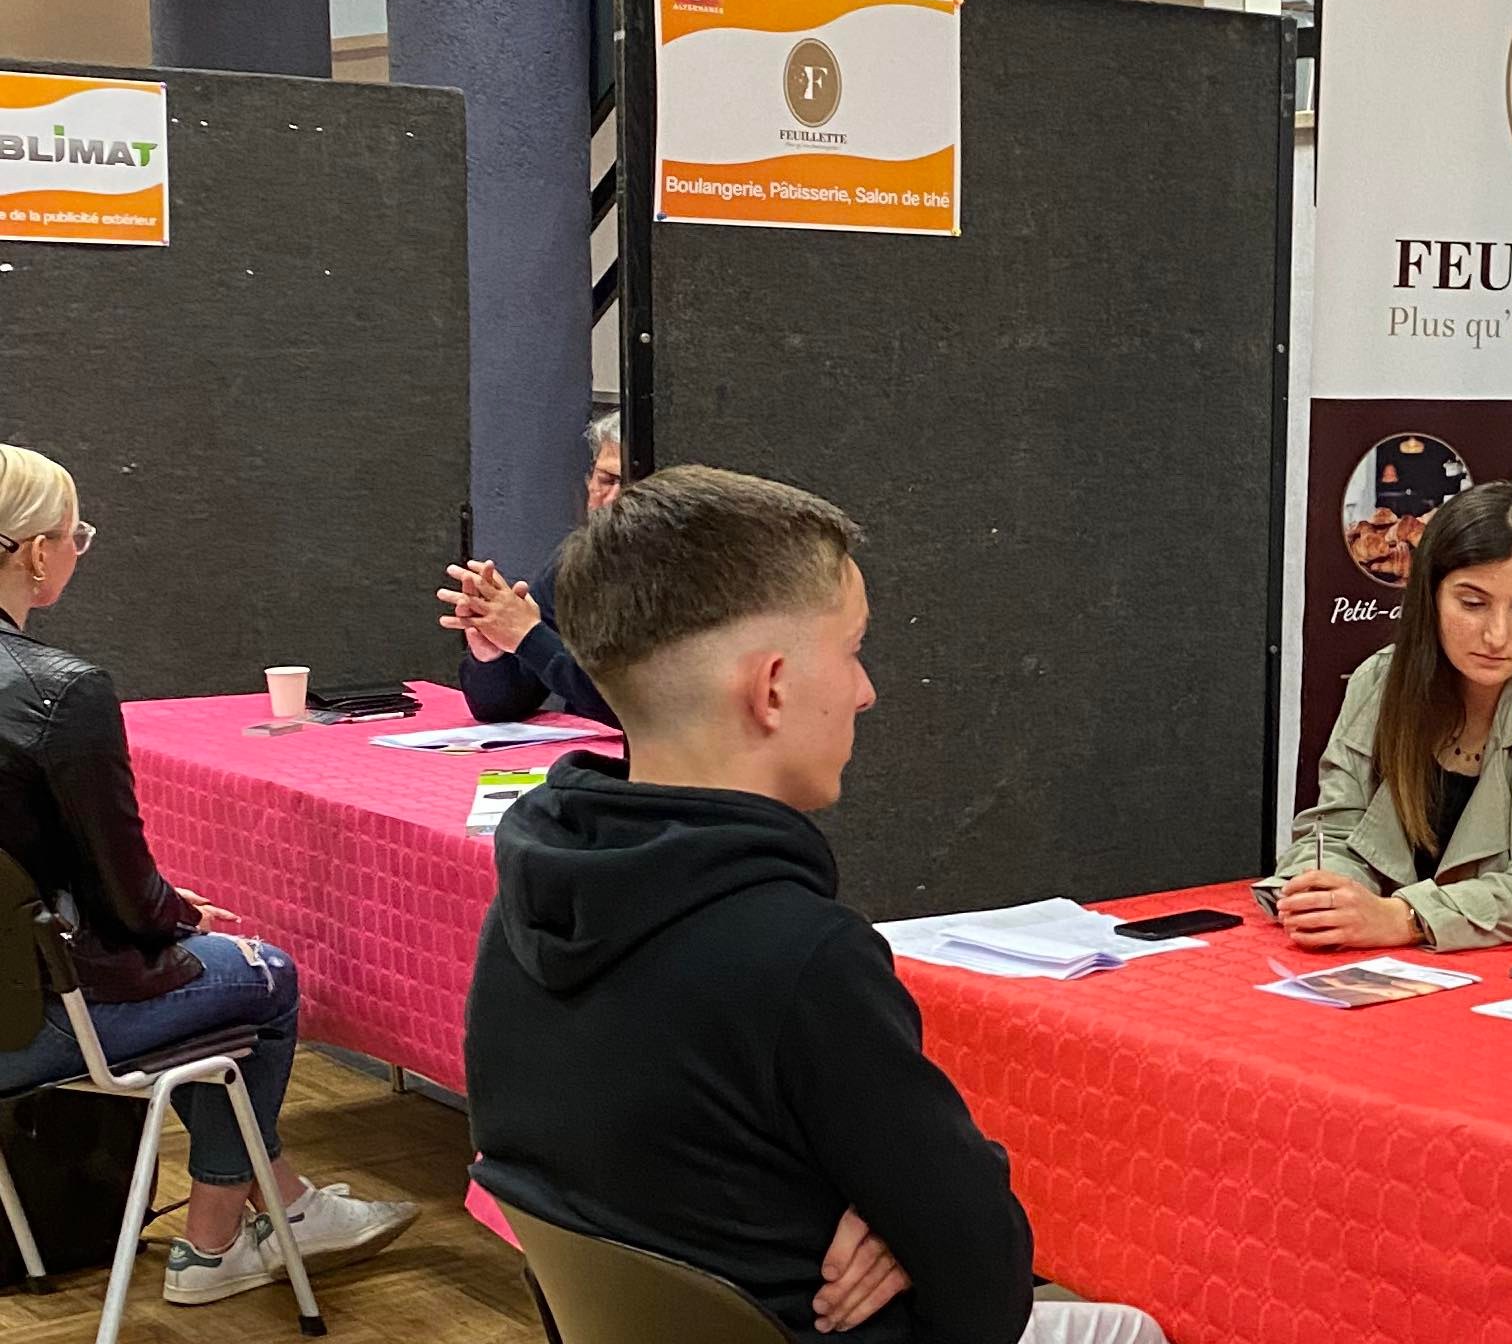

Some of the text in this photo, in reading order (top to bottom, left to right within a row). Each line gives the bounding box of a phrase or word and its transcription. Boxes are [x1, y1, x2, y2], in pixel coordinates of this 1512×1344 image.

[779, 129, 848, 145] FEUILLETTE
[665, 175, 950, 208] Boulangerie, Pâtisserie, Salon de thé
[9, 209, 27, 222] de
[29, 209, 41, 223] la
[43, 210, 99, 226] publicité
[1387, 306, 1456, 338] Plus
